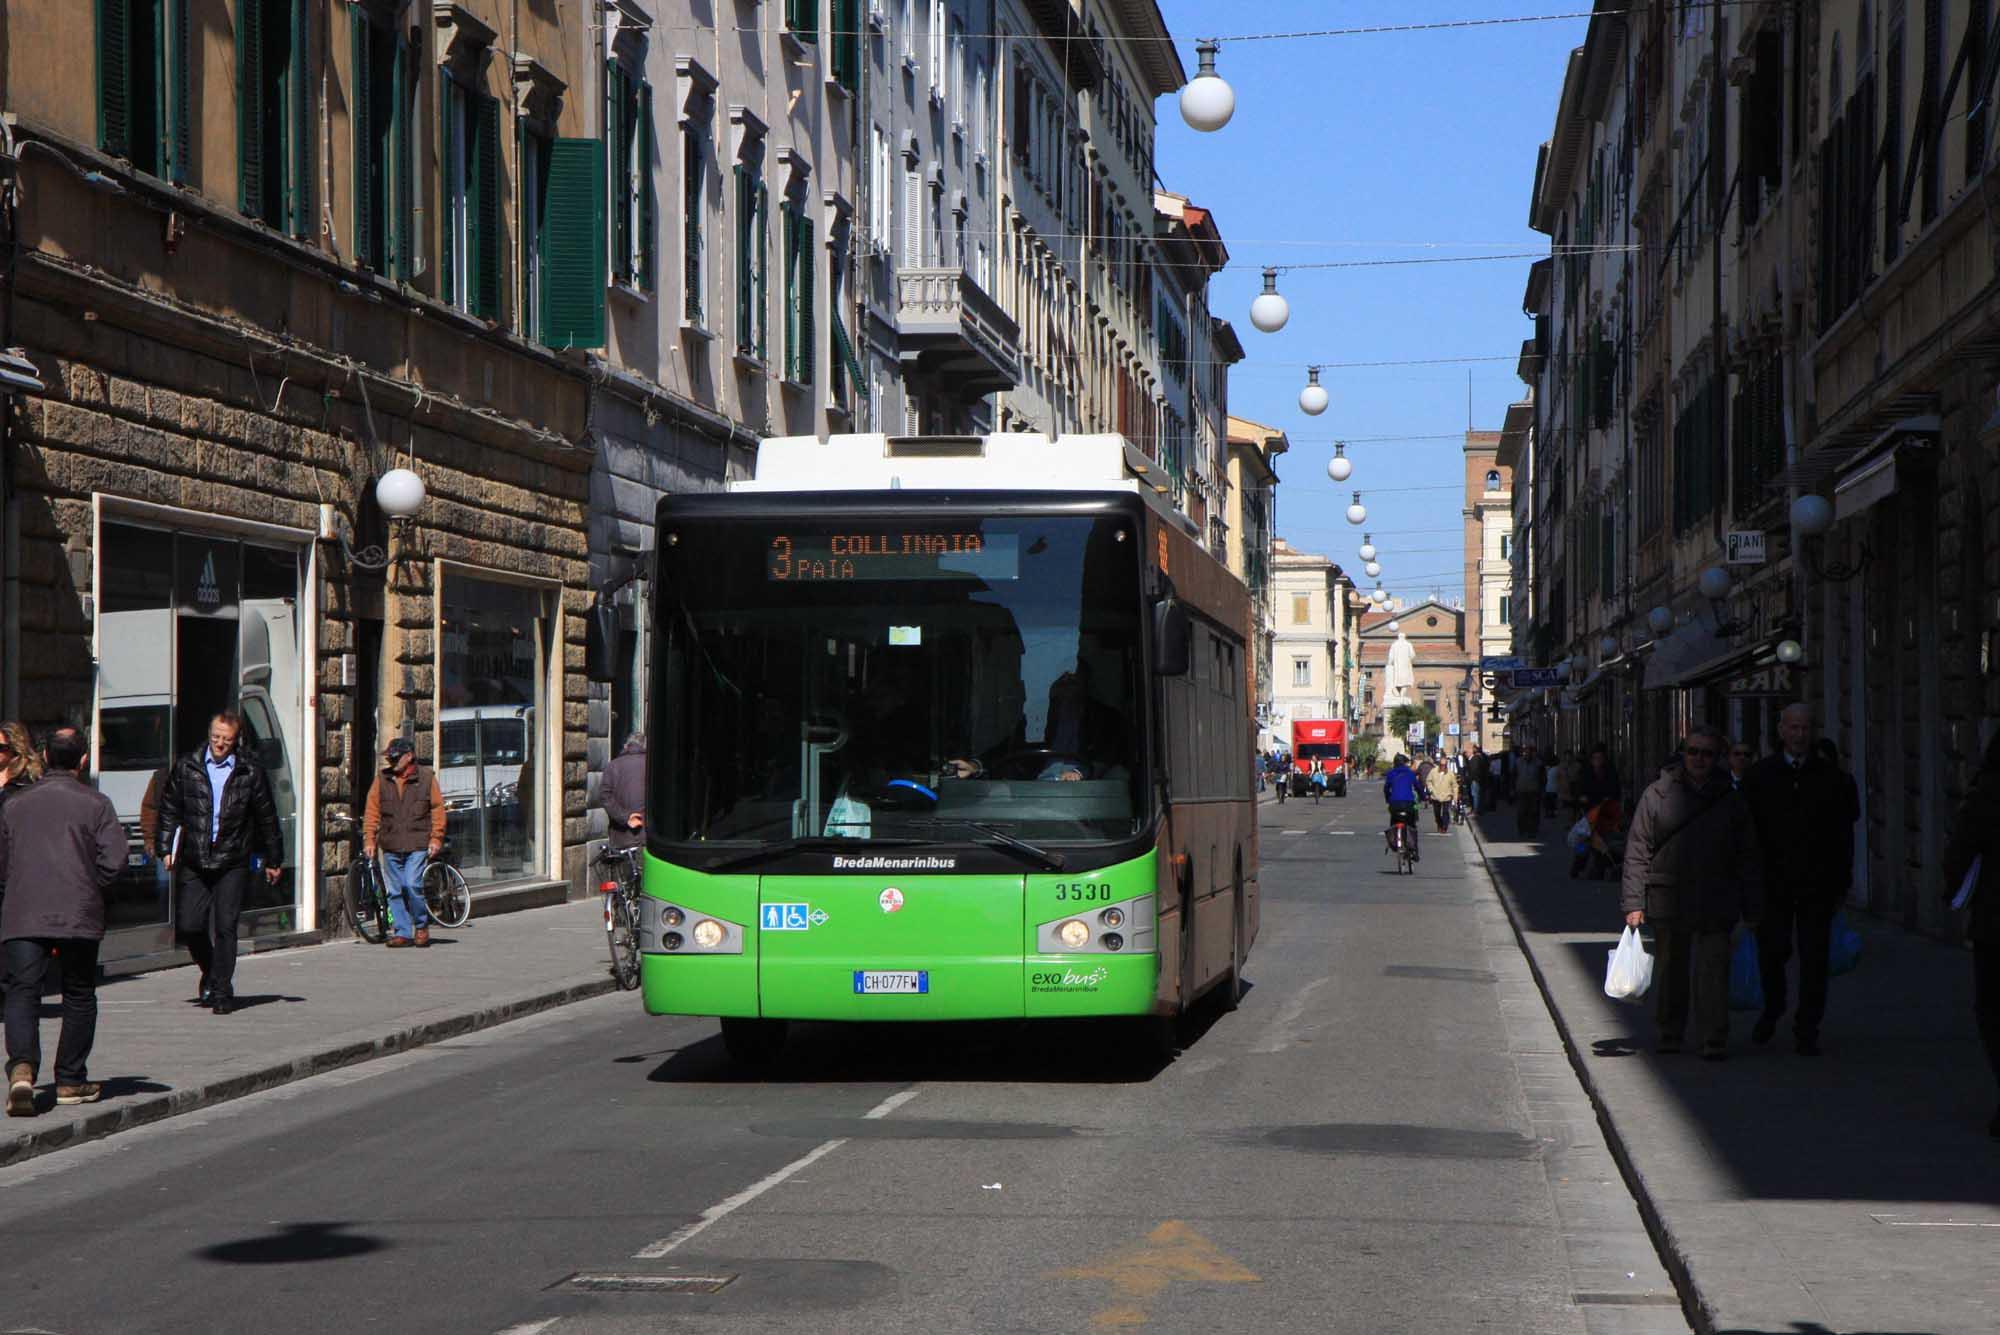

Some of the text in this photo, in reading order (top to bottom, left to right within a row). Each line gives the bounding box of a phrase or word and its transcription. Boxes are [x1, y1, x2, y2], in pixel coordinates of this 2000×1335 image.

[772, 535, 981, 579] 3 COLLINAIA
[798, 560, 854, 578] PAIA
[833, 856, 956, 869] BredaMenarinibus
[1055, 883, 1111, 900] 3530
